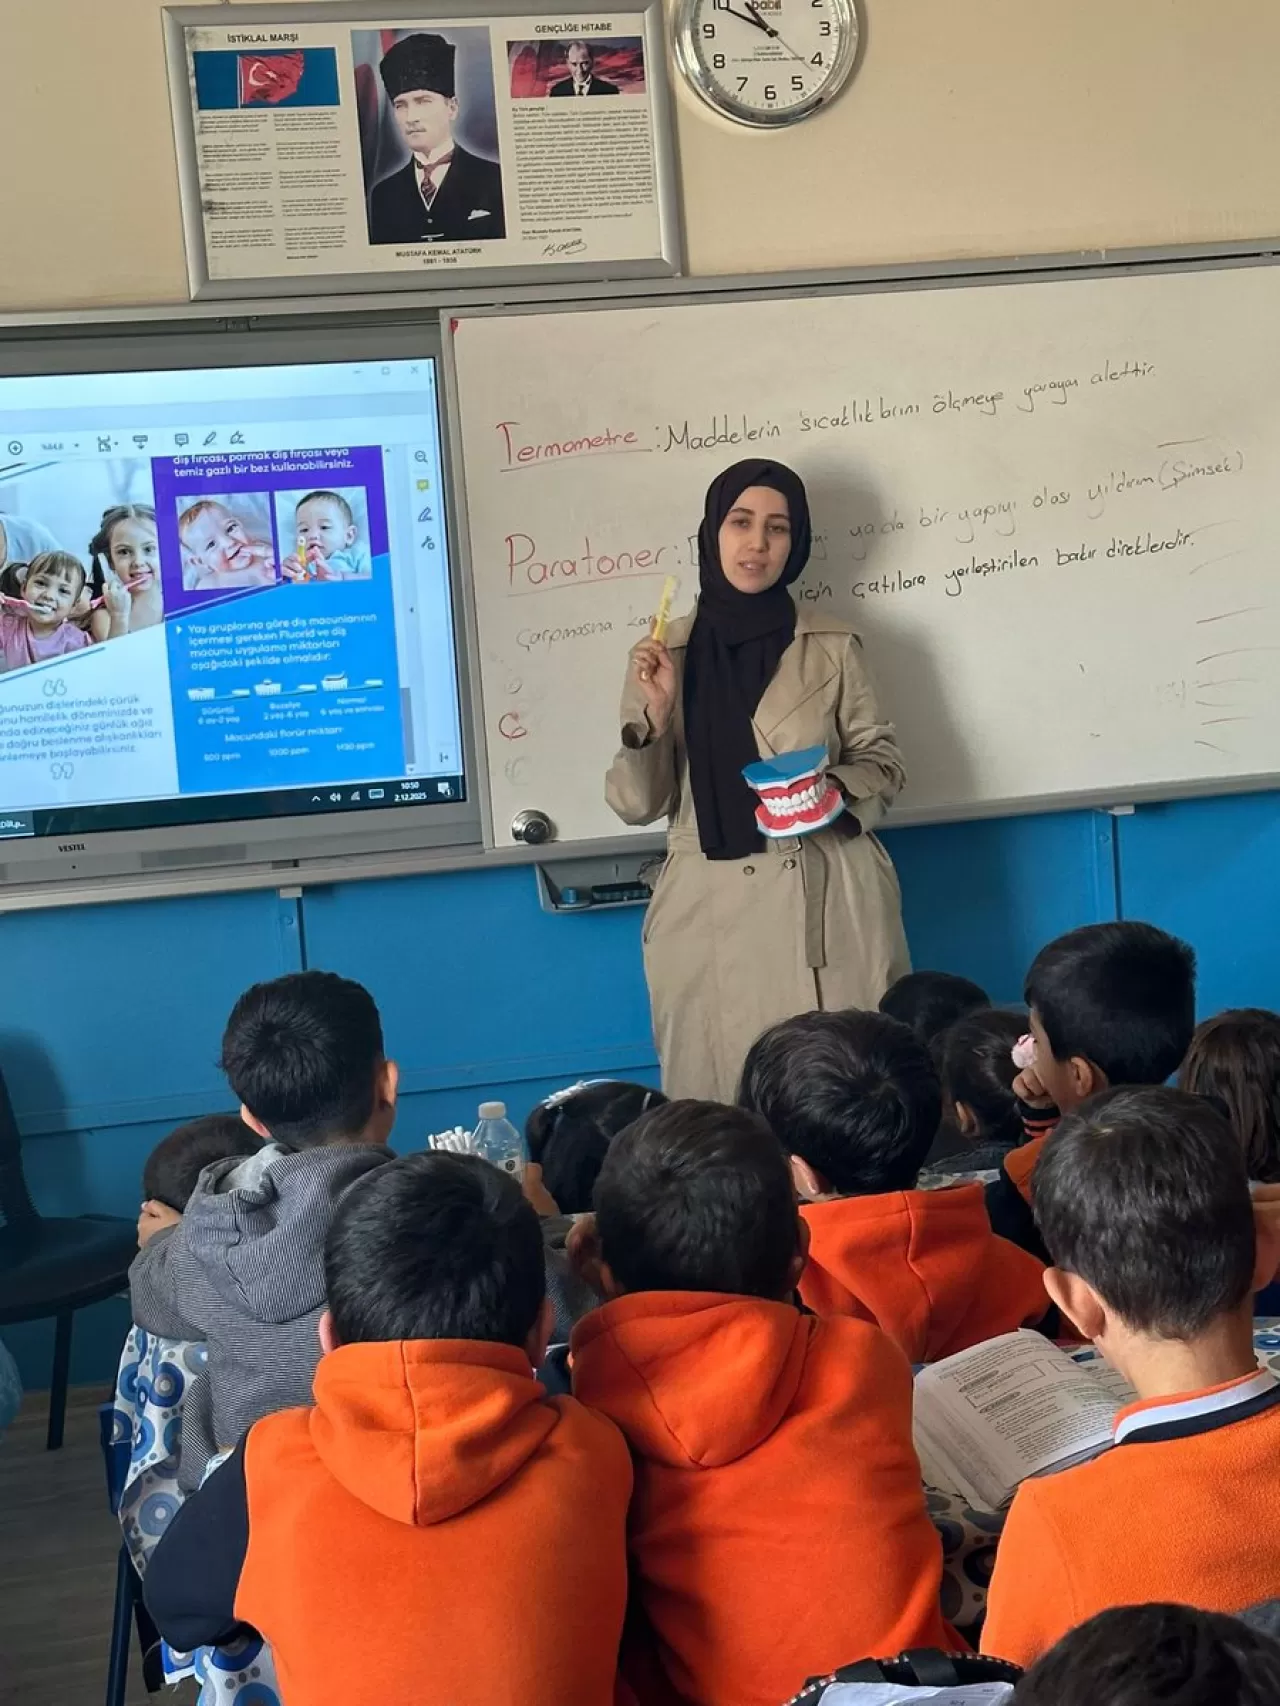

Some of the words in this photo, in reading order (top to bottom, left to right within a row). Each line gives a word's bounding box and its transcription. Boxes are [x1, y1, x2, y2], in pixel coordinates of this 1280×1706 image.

[534, 23, 579, 34] GENÇLİĞE
[581, 22, 612, 32] HİTABE
[703, 23, 715, 39] 9
[819, 21, 831, 36] 3
[227, 33, 267, 43] İSTİKLAL
[269, 33, 299, 43] MARŞI
[713, 53, 725, 69] 8
[810, 51, 823, 67] 4
[736, 77, 749, 92] 7
[791, 76, 803, 91] 5
[764, 85, 776, 101] 6
[174, 466, 204, 477] temiz
[233, 463, 249, 474] bir
[250, 463, 270, 473] bez
